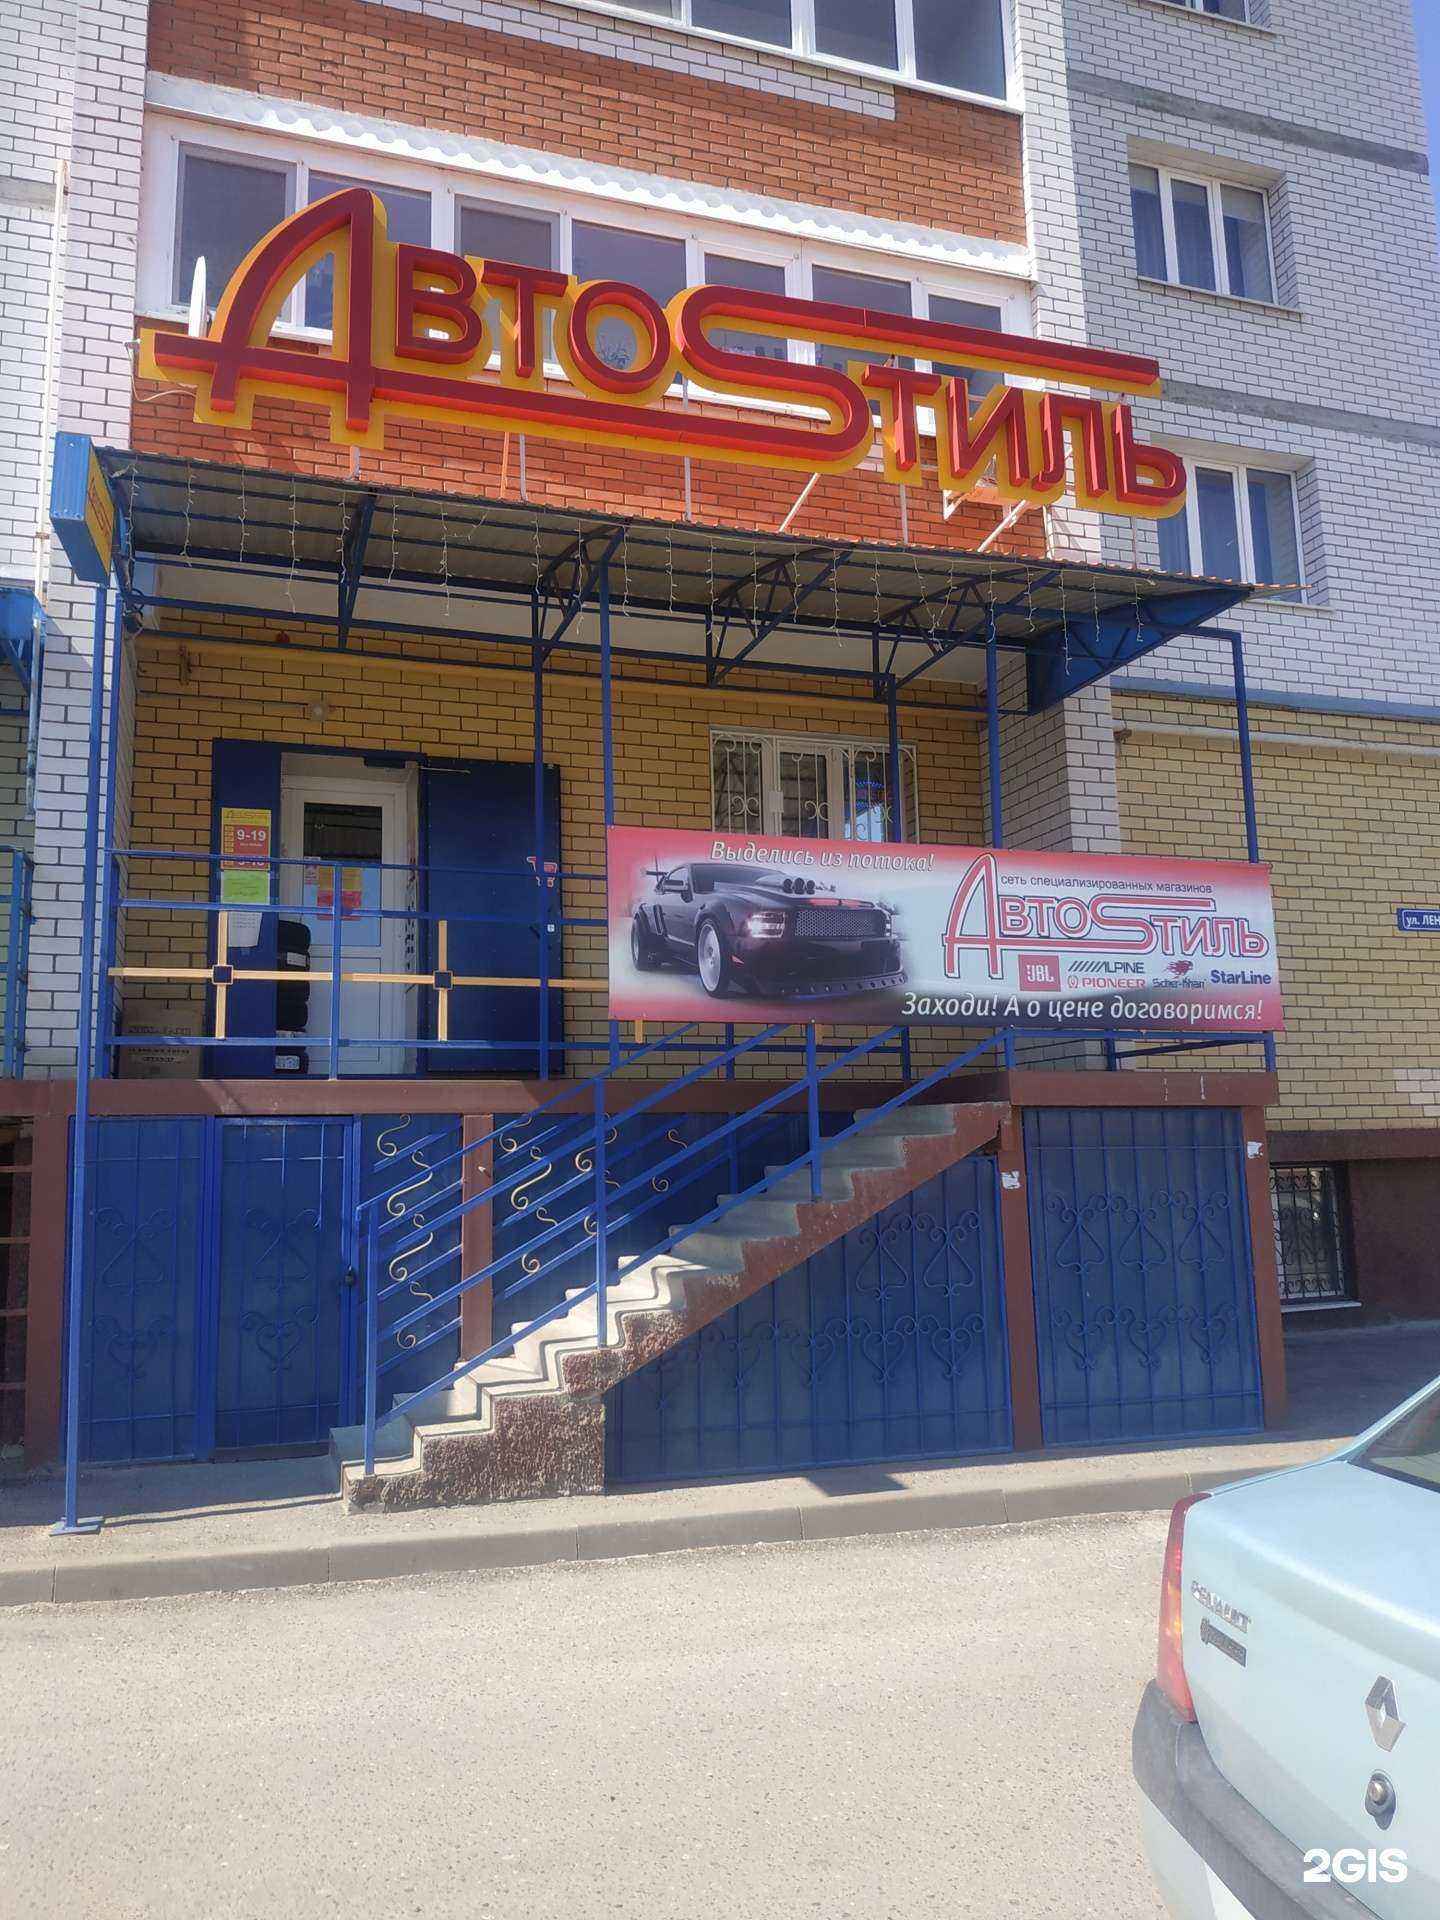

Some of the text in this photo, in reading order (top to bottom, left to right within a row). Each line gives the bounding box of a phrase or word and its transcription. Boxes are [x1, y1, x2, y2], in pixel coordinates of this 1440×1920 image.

[237, 829, 267, 841] 9-19
[711, 841, 935, 872] Выделись из потока!
[1000, 874, 1213, 894] сеть специализированных магазинов
[1406, 917, 1420, 927] ул.
[1027, 964, 1054, 983] JBL
[1210, 969, 1272, 985] StarLine
[1081, 977, 1146, 989] PIONEER
[902, 991, 1263, 1023] Заходи! А о цене договоримся!
